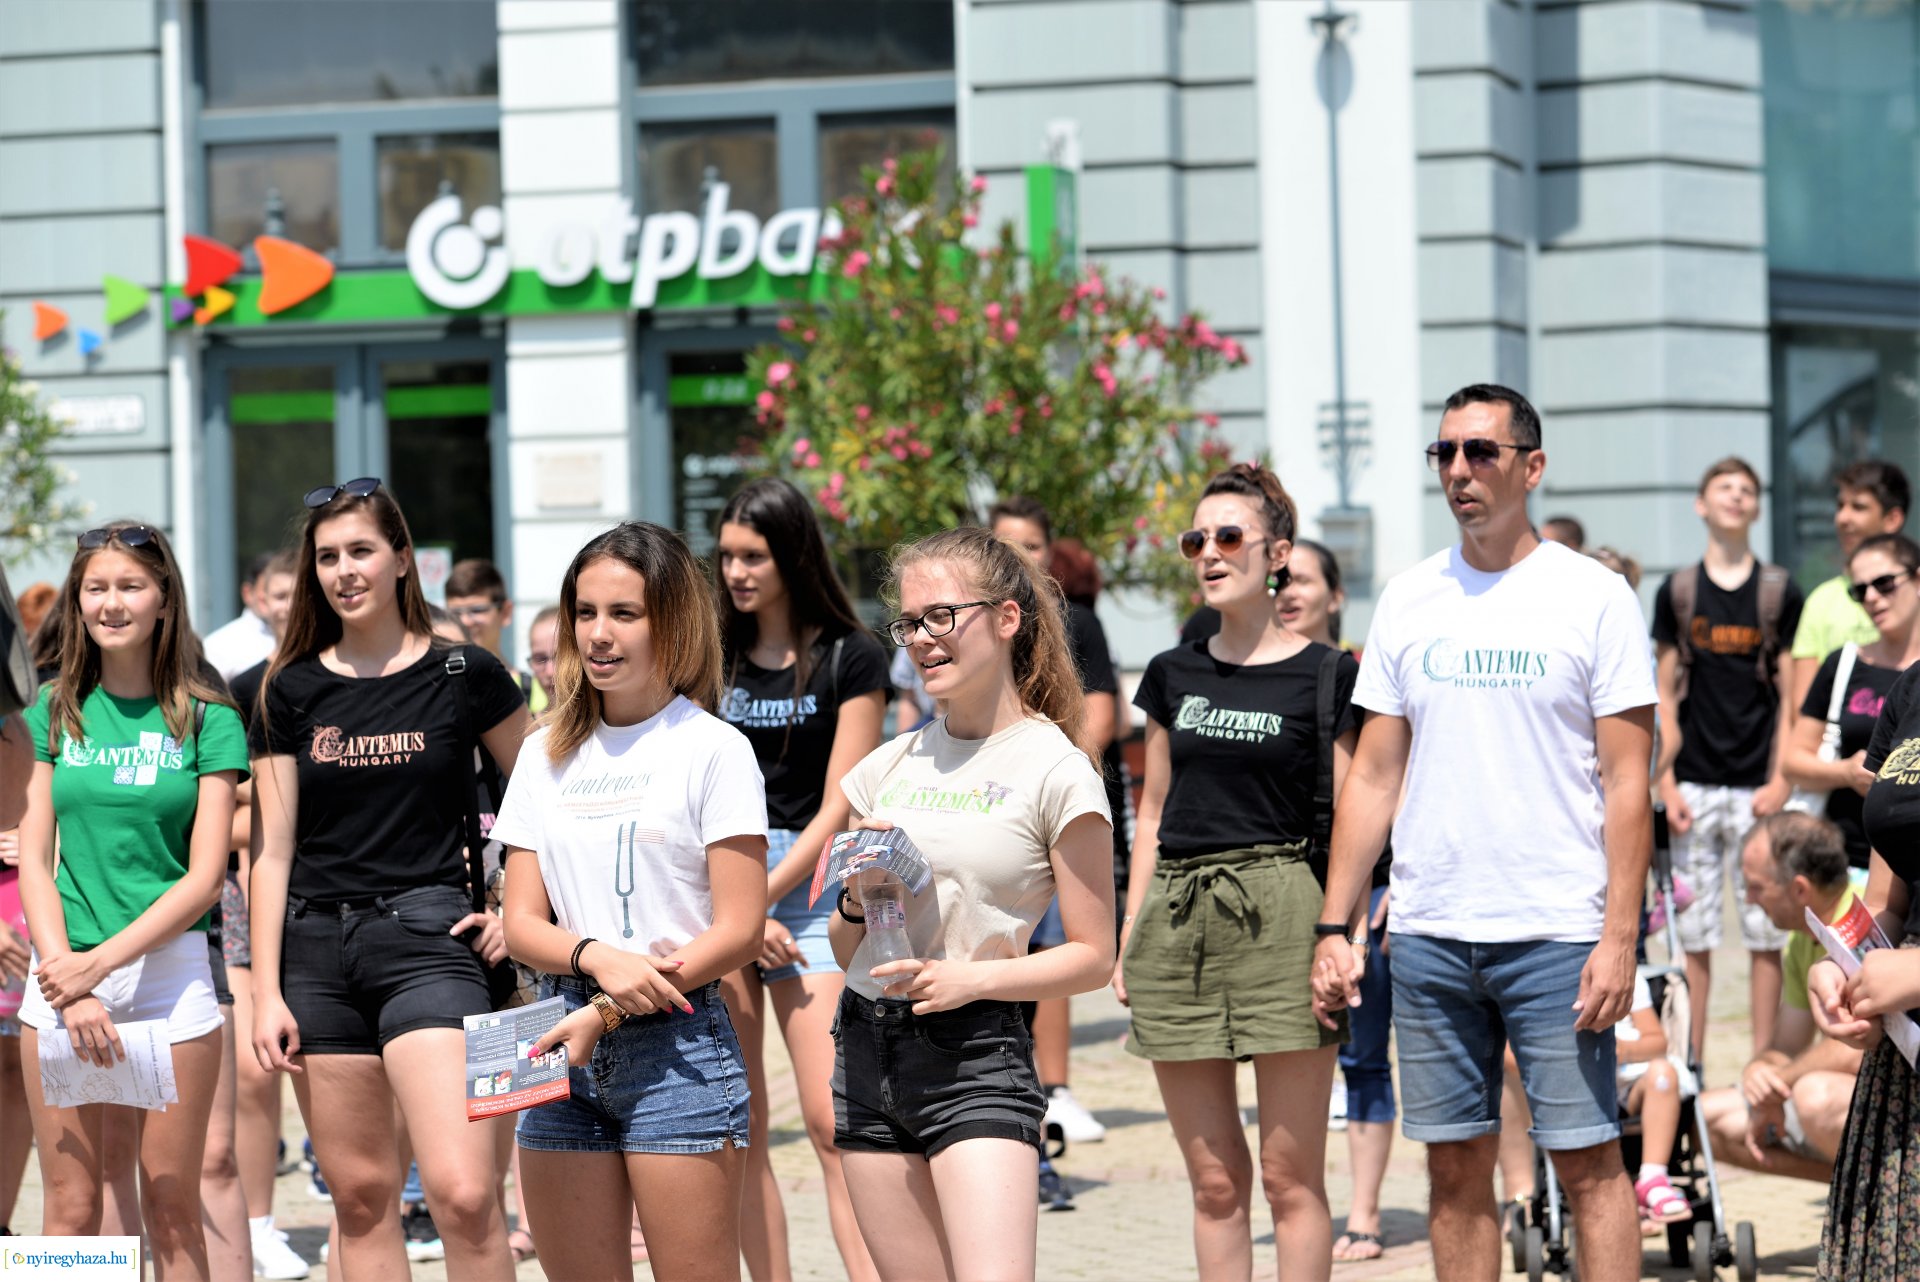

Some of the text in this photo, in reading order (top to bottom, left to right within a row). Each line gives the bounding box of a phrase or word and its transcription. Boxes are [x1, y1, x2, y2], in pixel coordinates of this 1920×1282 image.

[1421, 637, 1547, 682] CANTEMUS
[1455, 679, 1534, 690] HUNGARY
[1175, 694, 1283, 736] CANTEMUS
[62, 731, 183, 770] CANTEMUS
[309, 724, 425, 764] CANTEMUS
[1196, 726, 1265, 744] HUNGARY
[339, 753, 412, 767] HUNGARY
